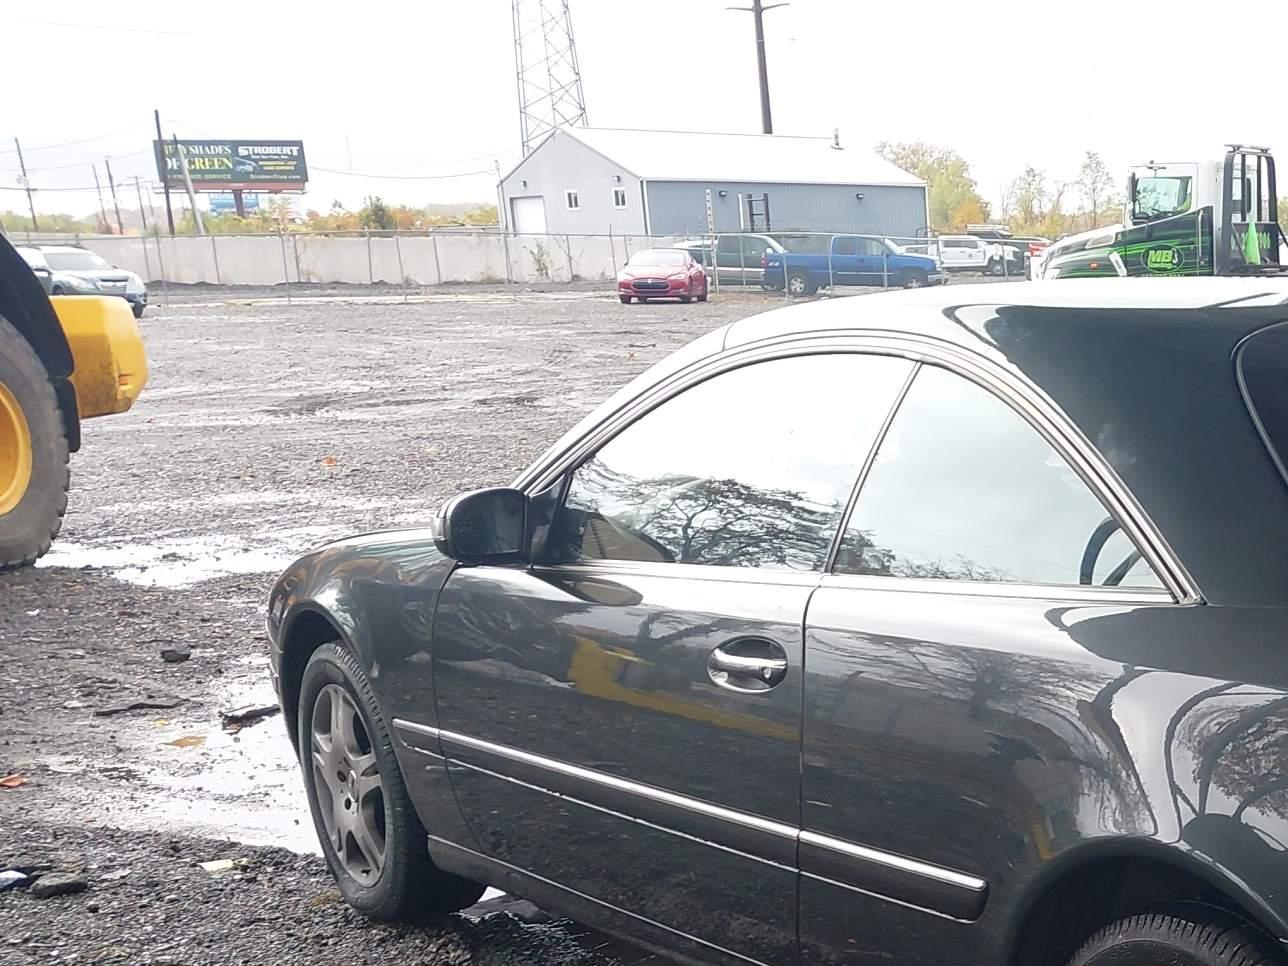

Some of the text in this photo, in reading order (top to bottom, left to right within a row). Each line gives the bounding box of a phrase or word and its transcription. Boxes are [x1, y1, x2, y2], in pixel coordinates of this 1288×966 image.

[188, 144, 232, 155] SHADES
[238, 146, 300, 156] STROBERT
[184, 157, 233, 170] GREEN
